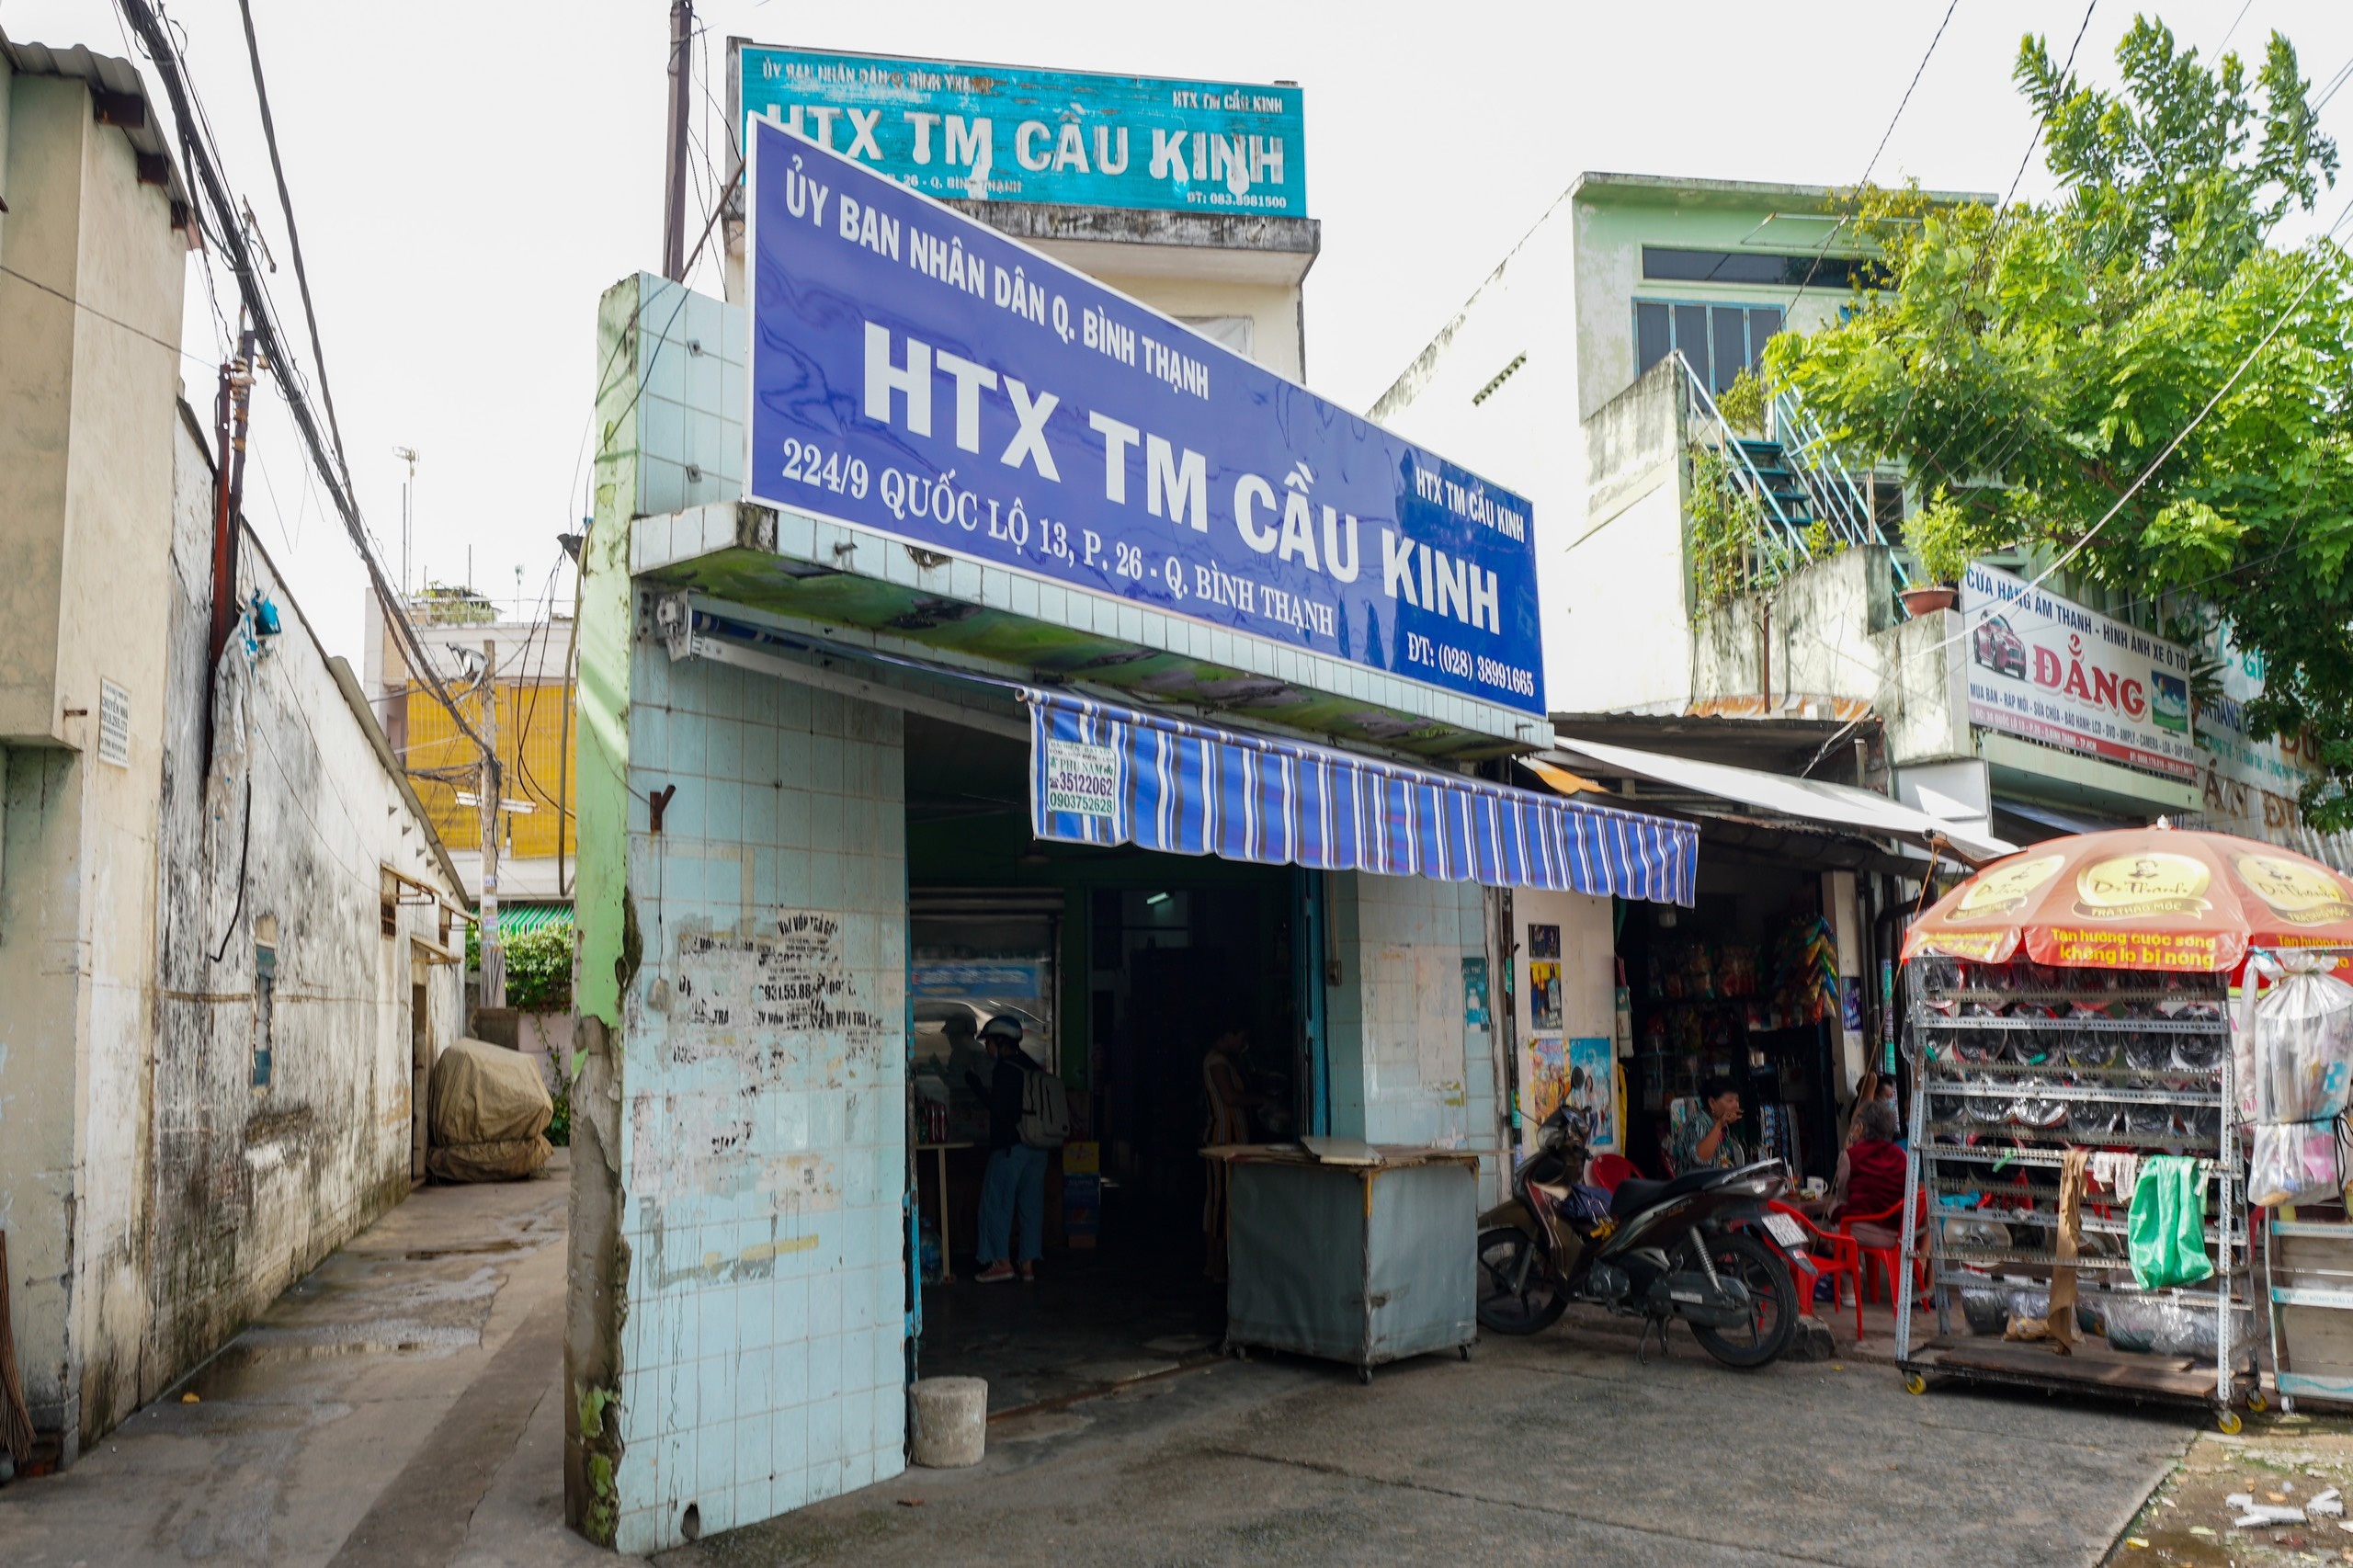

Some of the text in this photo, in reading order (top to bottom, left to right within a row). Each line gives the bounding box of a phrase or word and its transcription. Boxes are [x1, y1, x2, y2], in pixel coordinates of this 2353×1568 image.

[1173, 90, 1199, 108] HTX
[1201, 93, 1221, 109] TM
[1252, 96, 1283, 113] KINH
[904, 111, 994, 171] TM
[1015, 102, 1129, 175] CẦU
[1150, 128, 1284, 187] KINH
[786, 154, 1210, 401] ỦY BAN NHÂN DÂN Q. BÌNH THẠNH
[865, 321, 1500, 636] HTX TM CẦU KINH
[1415, 466, 1526, 543] HTX TM CẦU KINH
[782, 437, 870, 499] 224/9
[881, 469, 978, 531] QUỐC
[988, 497, 1029, 554] LỘ
[1039, 518, 1075, 568] 13,
[1082, 528, 1108, 572] P.
[1116, 541, 1142, 580] 26
[1165, 555, 1188, 600] Q.
[1195, 559, 1255, 614] BÌNH
[1261, 585, 1336, 637] THẠNH
[1966, 566, 1994, 597] CỬA
[2035, 590, 2052, 619] ÂM
[2056, 604, 2092, 636] THANH
[2103, 621, 2128, 649] HÌNH
[2154, 642, 2165, 664] XE
[2166, 645, 2173, 666] Ô
[2176, 651, 2187, 672] TÔ
[1407, 631, 1534, 698] ĐT: (028) 38991665
[2032, 634, 2146, 718] ĐẲNG
[1970, 682, 1984, 699] MUA
[1986, 685, 1998, 704] BÁN
[2005, 690, 2016, 709] RÁP
[2018, 694, 2029, 713] MỚI
[2140, 735, 2158, 750] CAMERA
[1050, 792, 1112, 813] 0903752628
[1060, 771, 1113, 797] 35122062
[2060, 945, 2117, 965] không
[2120, 946, 2137, 962] lo
[2142, 947, 2161, 968] bị
